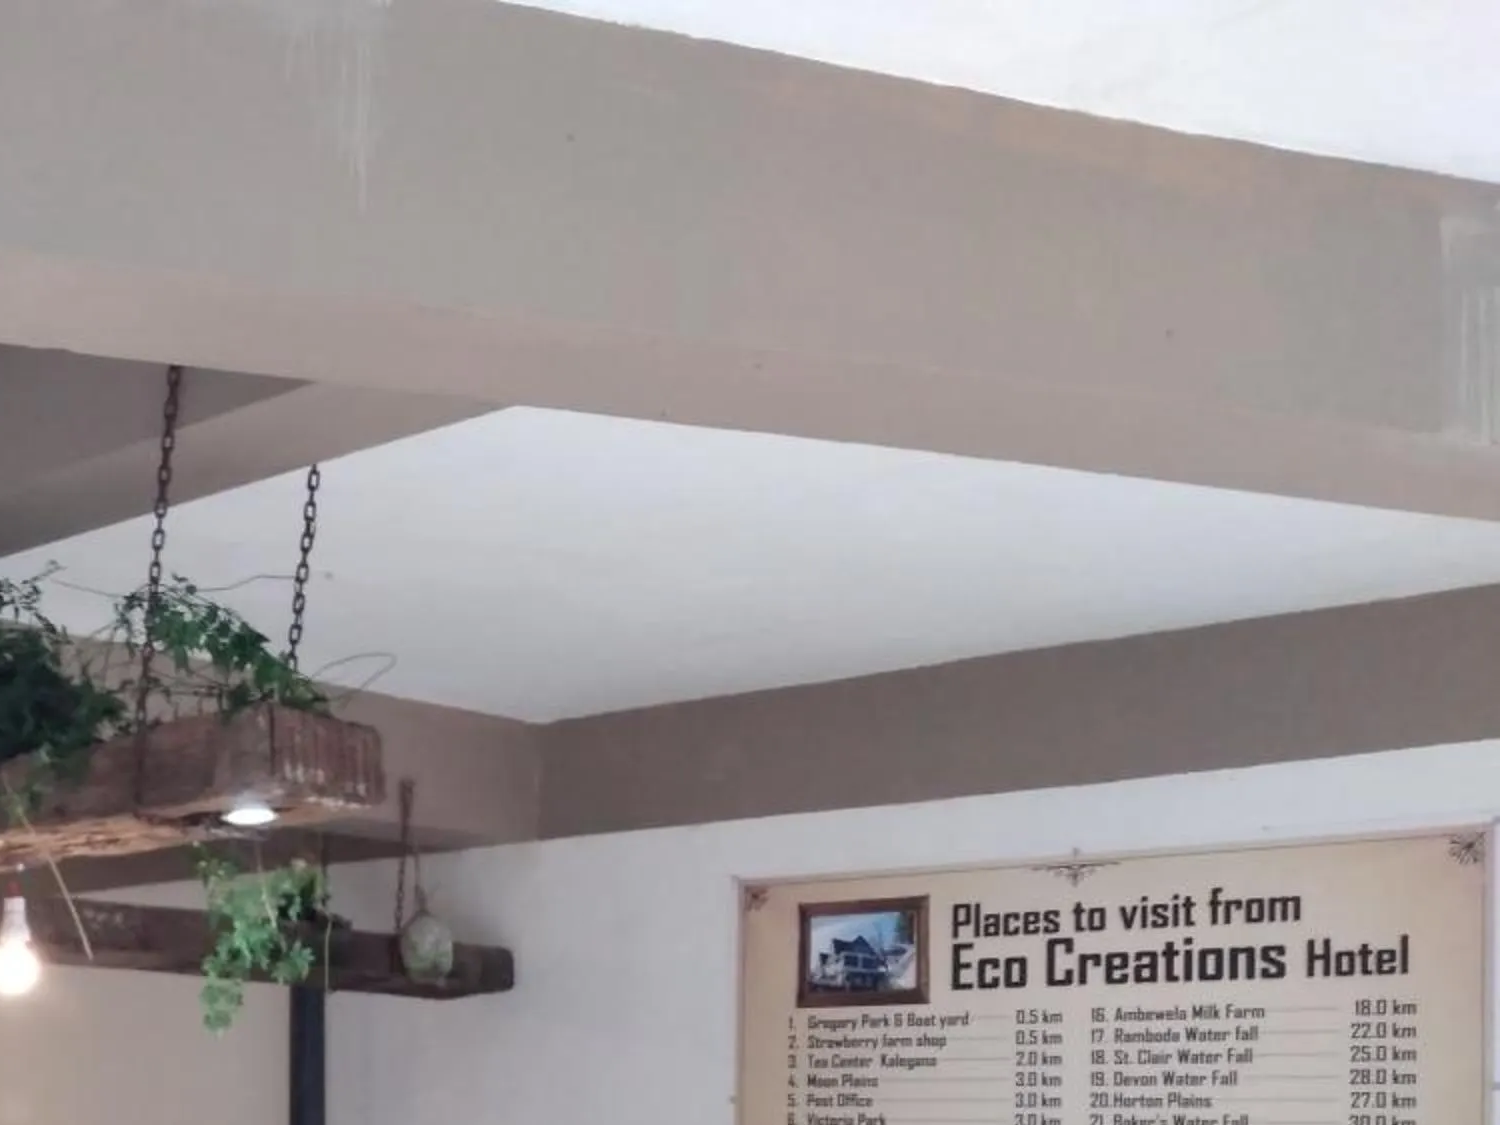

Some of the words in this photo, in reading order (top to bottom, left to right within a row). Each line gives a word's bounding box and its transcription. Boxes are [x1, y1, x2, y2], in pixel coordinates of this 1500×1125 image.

[951, 902, 1060, 939] Places
[1072, 900, 1106, 933] to
[1118, 894, 1197, 931] visit
[1208, 887, 1302, 926] from
[950, 941, 1028, 990] Eco
[1044, 935, 1287, 987] Creations
[1305, 933, 1409, 978] Hotel
[860, 1012, 890, 1029] Park
[906, 1011, 936, 1028] Boat
[938, 1010, 970, 1030] yard
[1015, 1008, 1038, 1025] 0.5
[1040, 1009, 1063, 1025] km
[1191, 1002, 1221, 1021] Milk
[1224, 1001, 1266, 1020] Farm
[1354, 997, 1388, 1017] 18.0
[1391, 997, 1417, 1016] km
[881, 1032, 913, 1048] farm
[915, 1032, 947, 1050] shop
[1015, 1028, 1038, 1046] 0.5
[1040, 1028, 1063, 1045] km
[1183, 1025, 1231, 1043] Water
[1234, 1024, 1259, 1042] fall
[1350, 1020, 1388, 1041] 22.0
[1391, 1020, 1417, 1039] km
[807, 1053, 829, 1069] Tea
[830, 1052, 873, 1068] Center
[1014, 1050, 1038, 1067] 2.0
[1040, 1050, 1062, 1066] km
[1136, 1047, 1173, 1065] Clair
[1176, 1047, 1223, 1065] Water
[1226, 1046, 1254, 1064] Fall
[1349, 1043, 1387, 1063] 25.0
[1390, 1044, 1417, 1062] km
[840, 1072, 879, 1088] Plains
[1014, 1070, 1038, 1088] 3.0
[1040, 1070, 1062, 1087] km
[1112, 1070, 1158, 1087] Devon
[1161, 1069, 1207, 1087] Water
[1210, 1068, 1238, 1086] Fall
[1348, 1067, 1387, 1086] 28.0
[1390, 1068, 1417, 1085] km
[836, 1091, 874, 1108] Office
[1014, 1090, 1038, 1109] 3.0
[1040, 1091, 1062, 1108] km
[1166, 1090, 1213, 1109] Plains
[1349, 1090, 1387, 1109] 27.0
[1390, 1091, 1417, 1109] km
